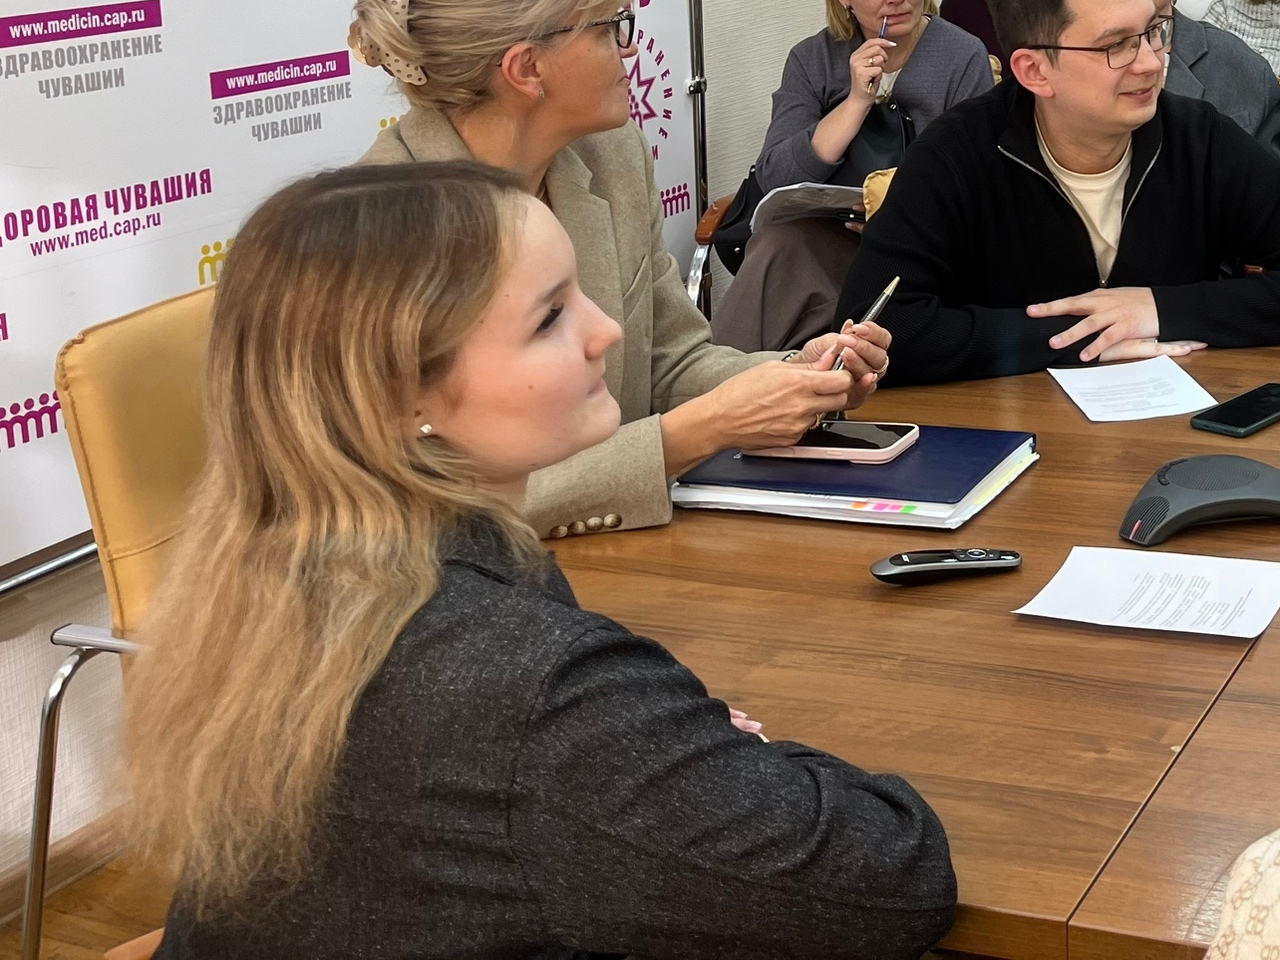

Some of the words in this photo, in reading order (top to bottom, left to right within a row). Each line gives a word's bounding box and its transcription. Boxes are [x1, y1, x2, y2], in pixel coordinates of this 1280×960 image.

[9, 9, 145, 38] www.medicin.cap.ru
[38, 67, 126, 99] ЧУВАШИИ
[226, 60, 337, 89] www.medicin.cap.ru
[213, 82, 352, 125] ЗДРАВООХРАНЕНИЕ
[252, 112, 322, 142] ЧУВАШИИ
[0, 194, 99, 247] ОРОВАЯ
[104, 168, 212, 215] ЧУВАШИЯ
[30, 212, 161, 257] www.med.cap.ru
